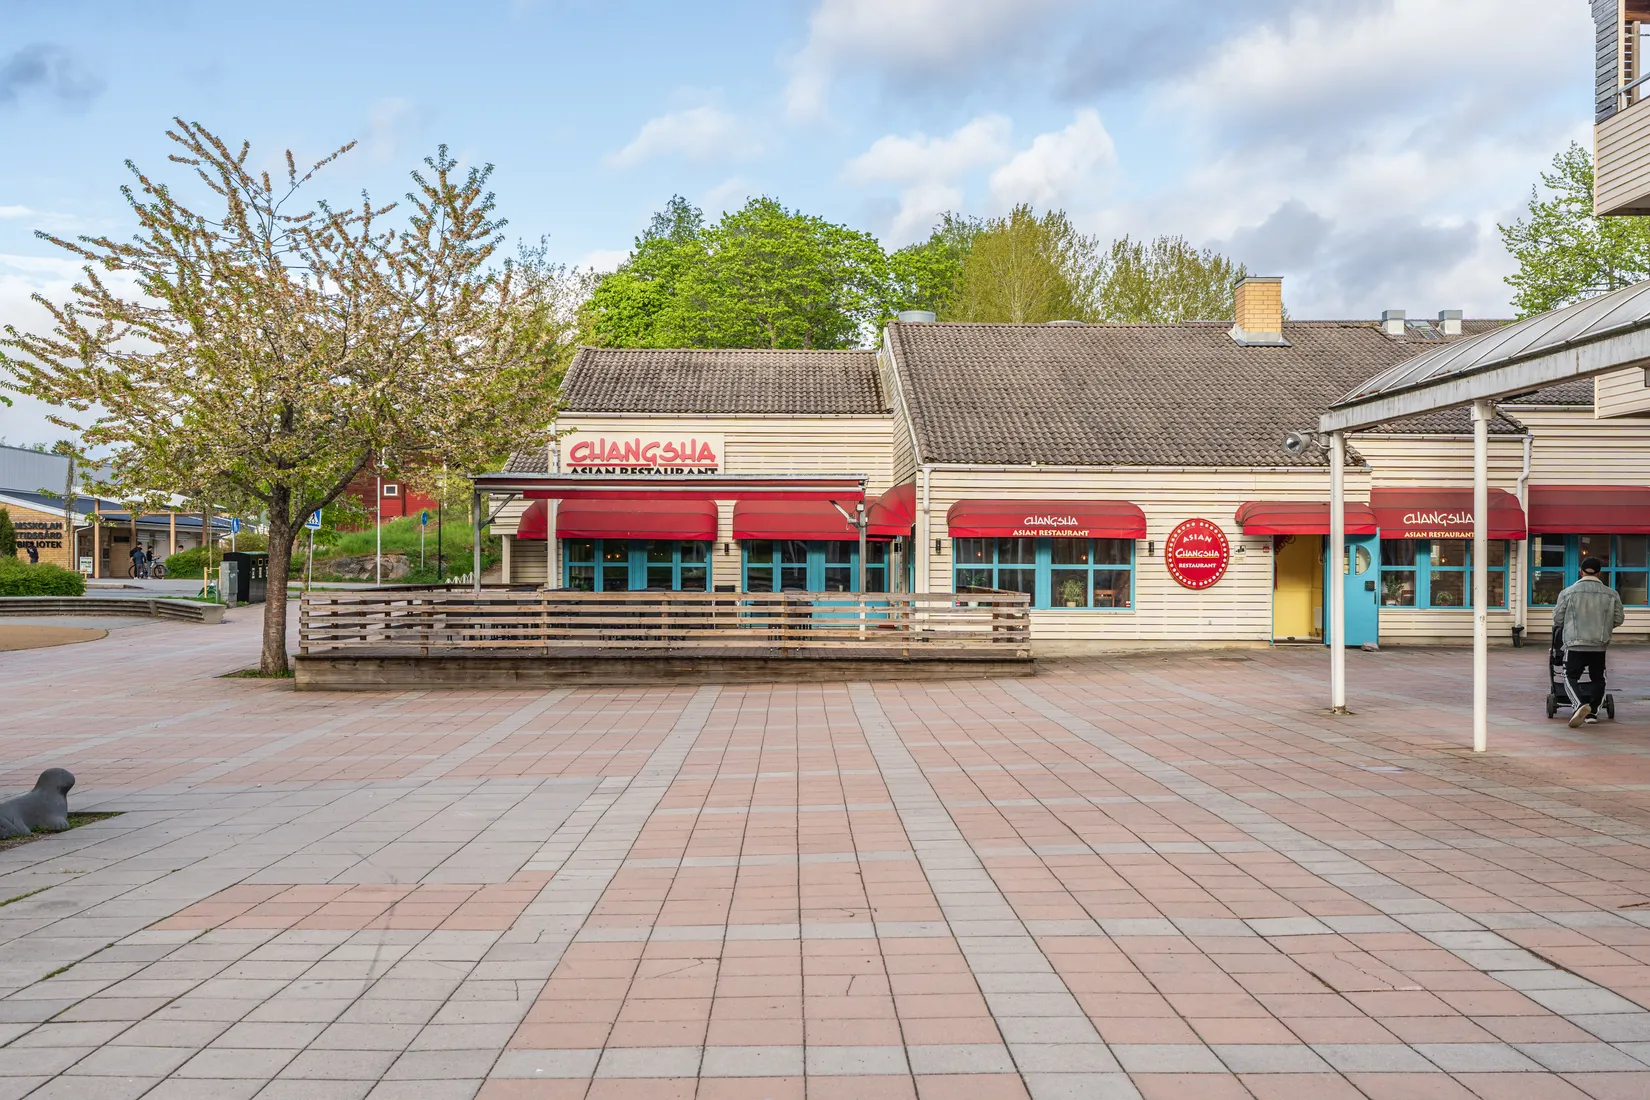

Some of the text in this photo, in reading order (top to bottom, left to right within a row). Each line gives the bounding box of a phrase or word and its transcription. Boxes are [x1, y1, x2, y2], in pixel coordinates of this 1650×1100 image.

[569, 438, 716, 466] CHANGSHA
[1023, 514, 1079, 528] CHANGSHA
[1403, 511, 1475, 527] CHANGSHA
[1012, 529, 1090, 537] ASIAN RESTAURANT
[1182, 533, 1213, 544] ASIAN
